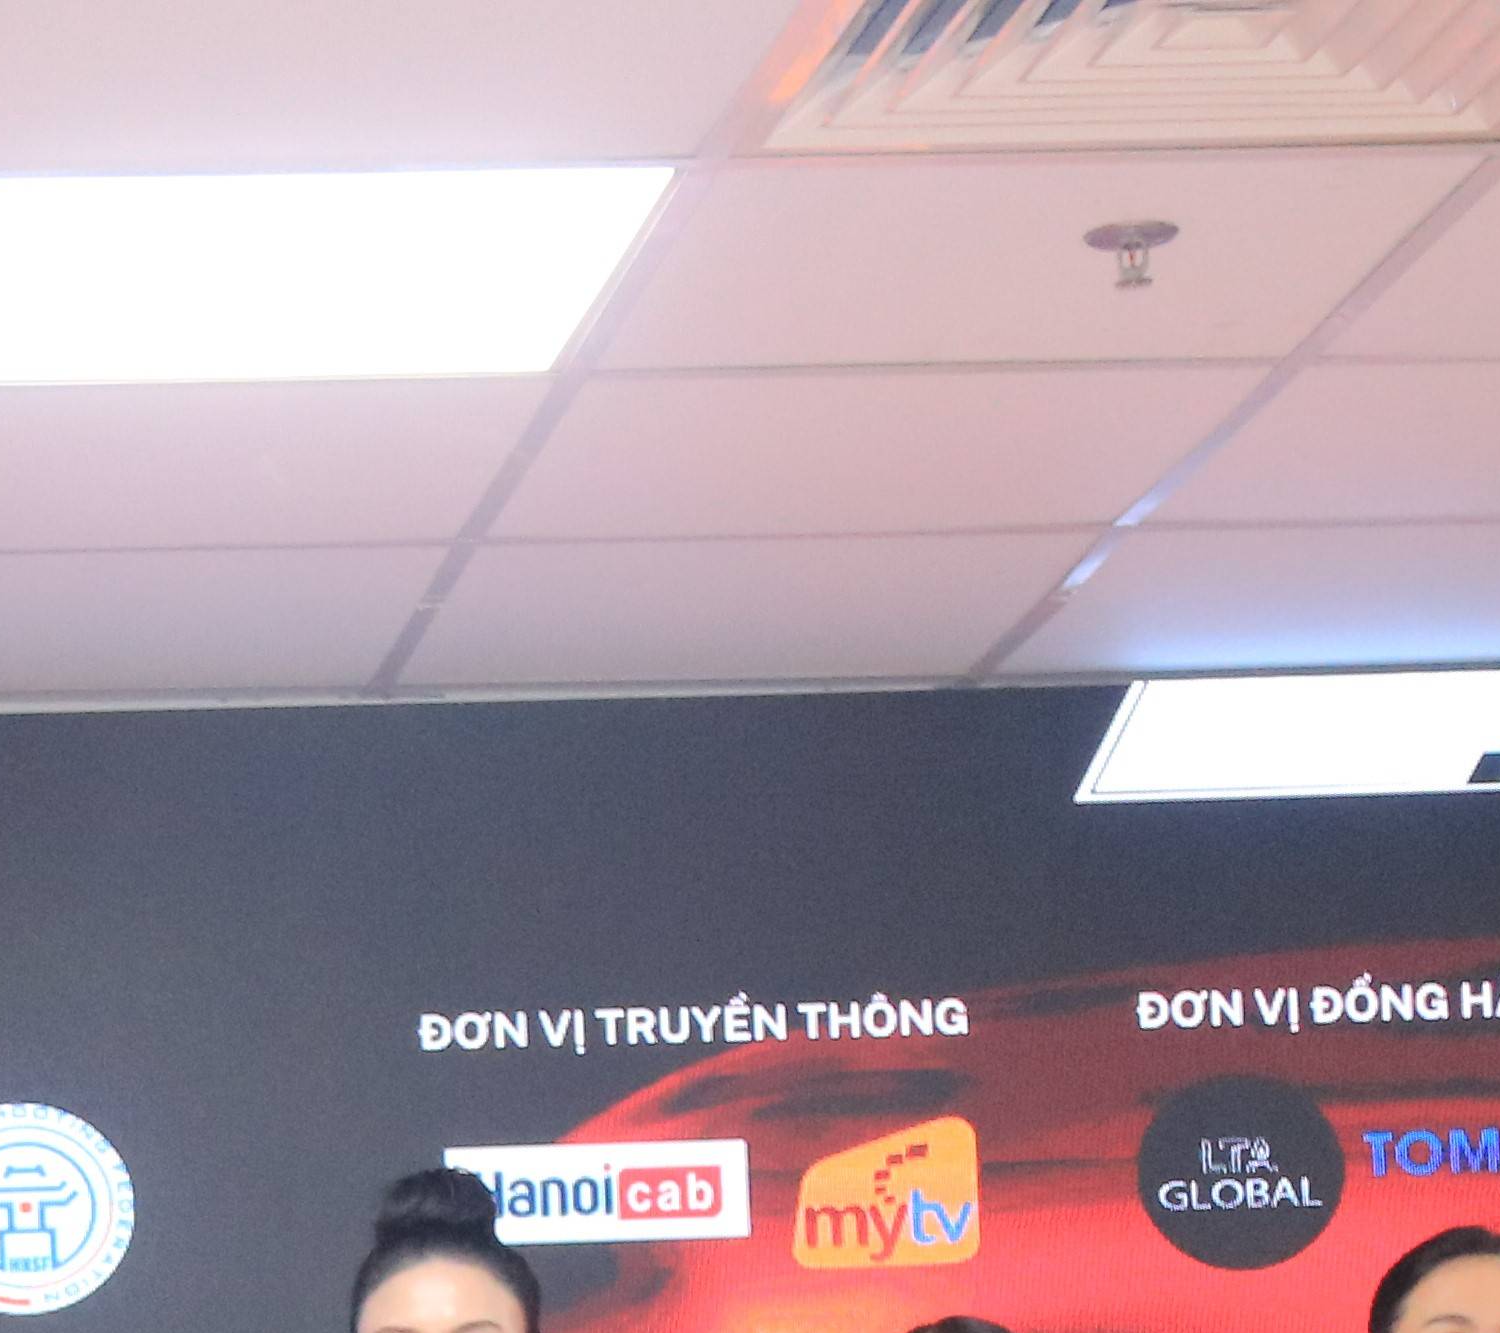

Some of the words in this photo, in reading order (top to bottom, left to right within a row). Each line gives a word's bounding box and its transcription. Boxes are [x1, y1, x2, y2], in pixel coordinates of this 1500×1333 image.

[418, 1010, 528, 1051] ĐƠN
[541, 1009, 585, 1055] VỊ
[594, 991, 787, 1045] TRUYỀN
[797, 991, 969, 1040] THÔNG
[1136, 989, 1244, 1029] ĐƠN
[1254, 987, 1300, 1033] VỊ
[1309, 972, 1449, 1024] ĐỒNG
[804, 1188, 972, 1260] mytv
[1158, 1176, 1323, 1211] GLOBAL
